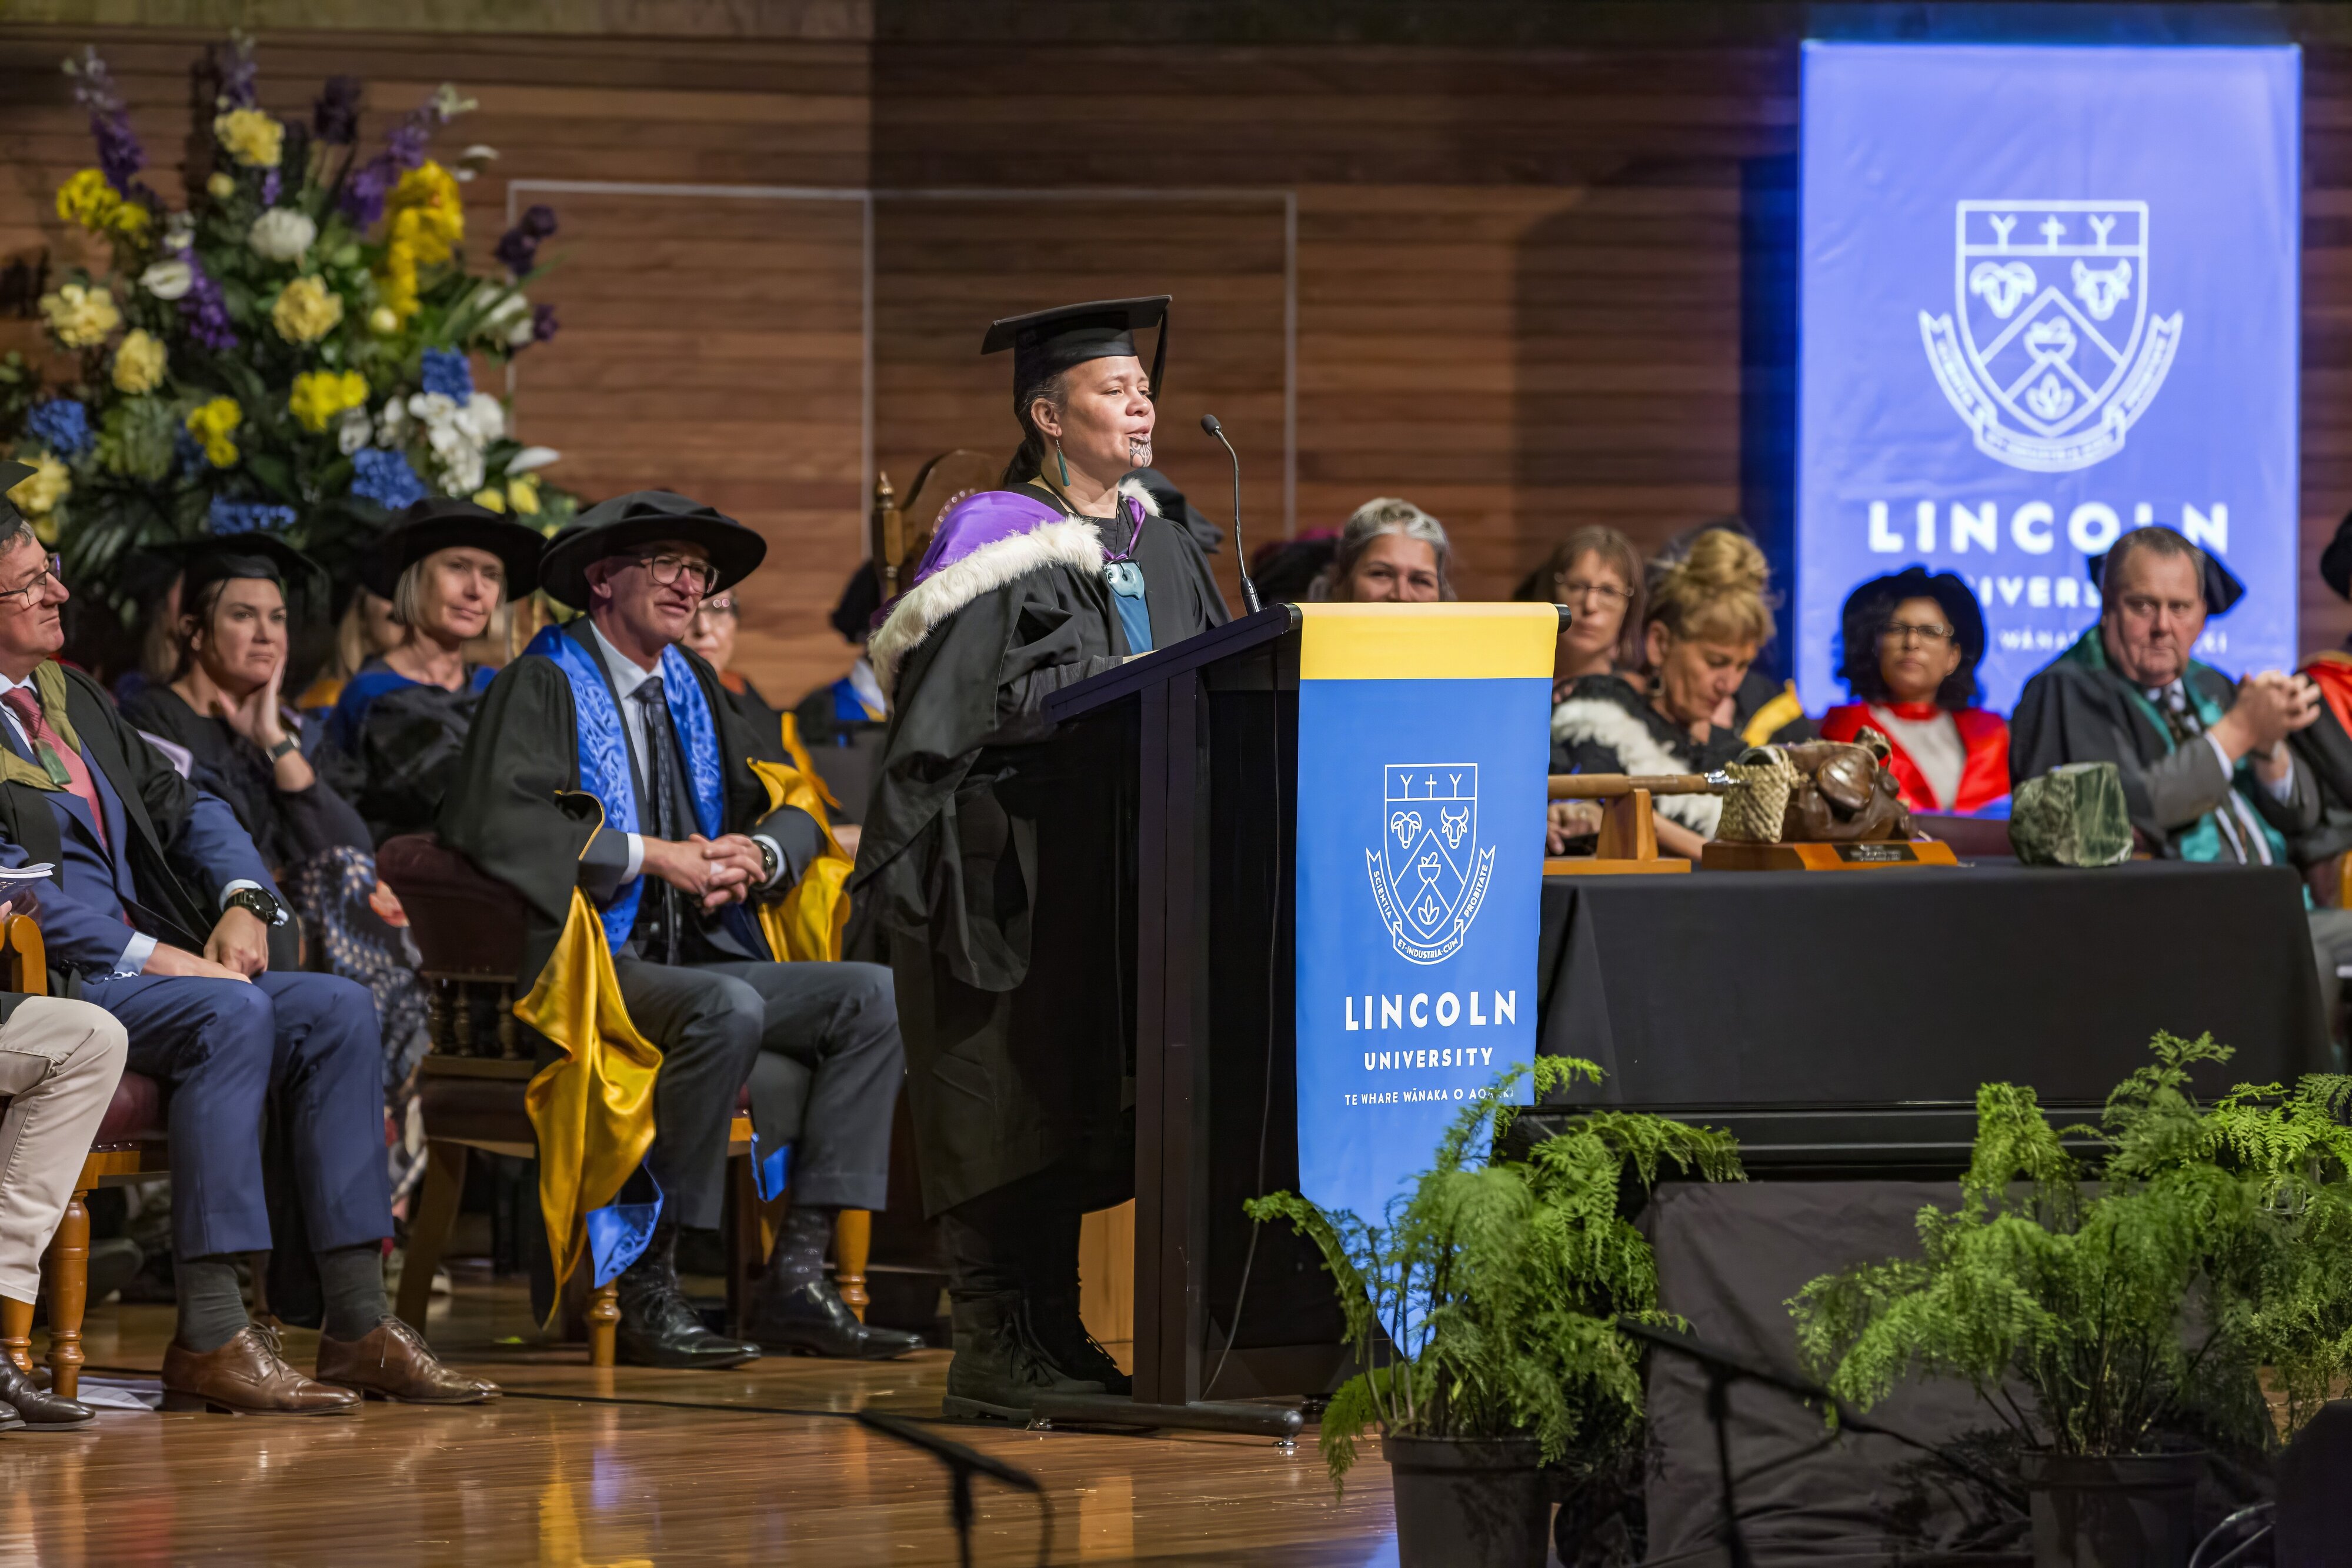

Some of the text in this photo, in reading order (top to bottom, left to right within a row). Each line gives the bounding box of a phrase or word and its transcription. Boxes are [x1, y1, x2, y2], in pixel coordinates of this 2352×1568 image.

[1373, 870, 1392, 919] SCIENTIA
[1464, 864, 1488, 918] PROBITATE
[1345, 990, 1516, 1031] LINCOLN
[1365, 1047, 1493, 1070] UNIVERSITY
[1345, 1094, 1357, 1106] TE
[1361, 1091, 1398, 1104] WHARE
[1403, 1087, 1447, 1102] WĀNAKA
[1453, 1088, 1463, 1100] O
